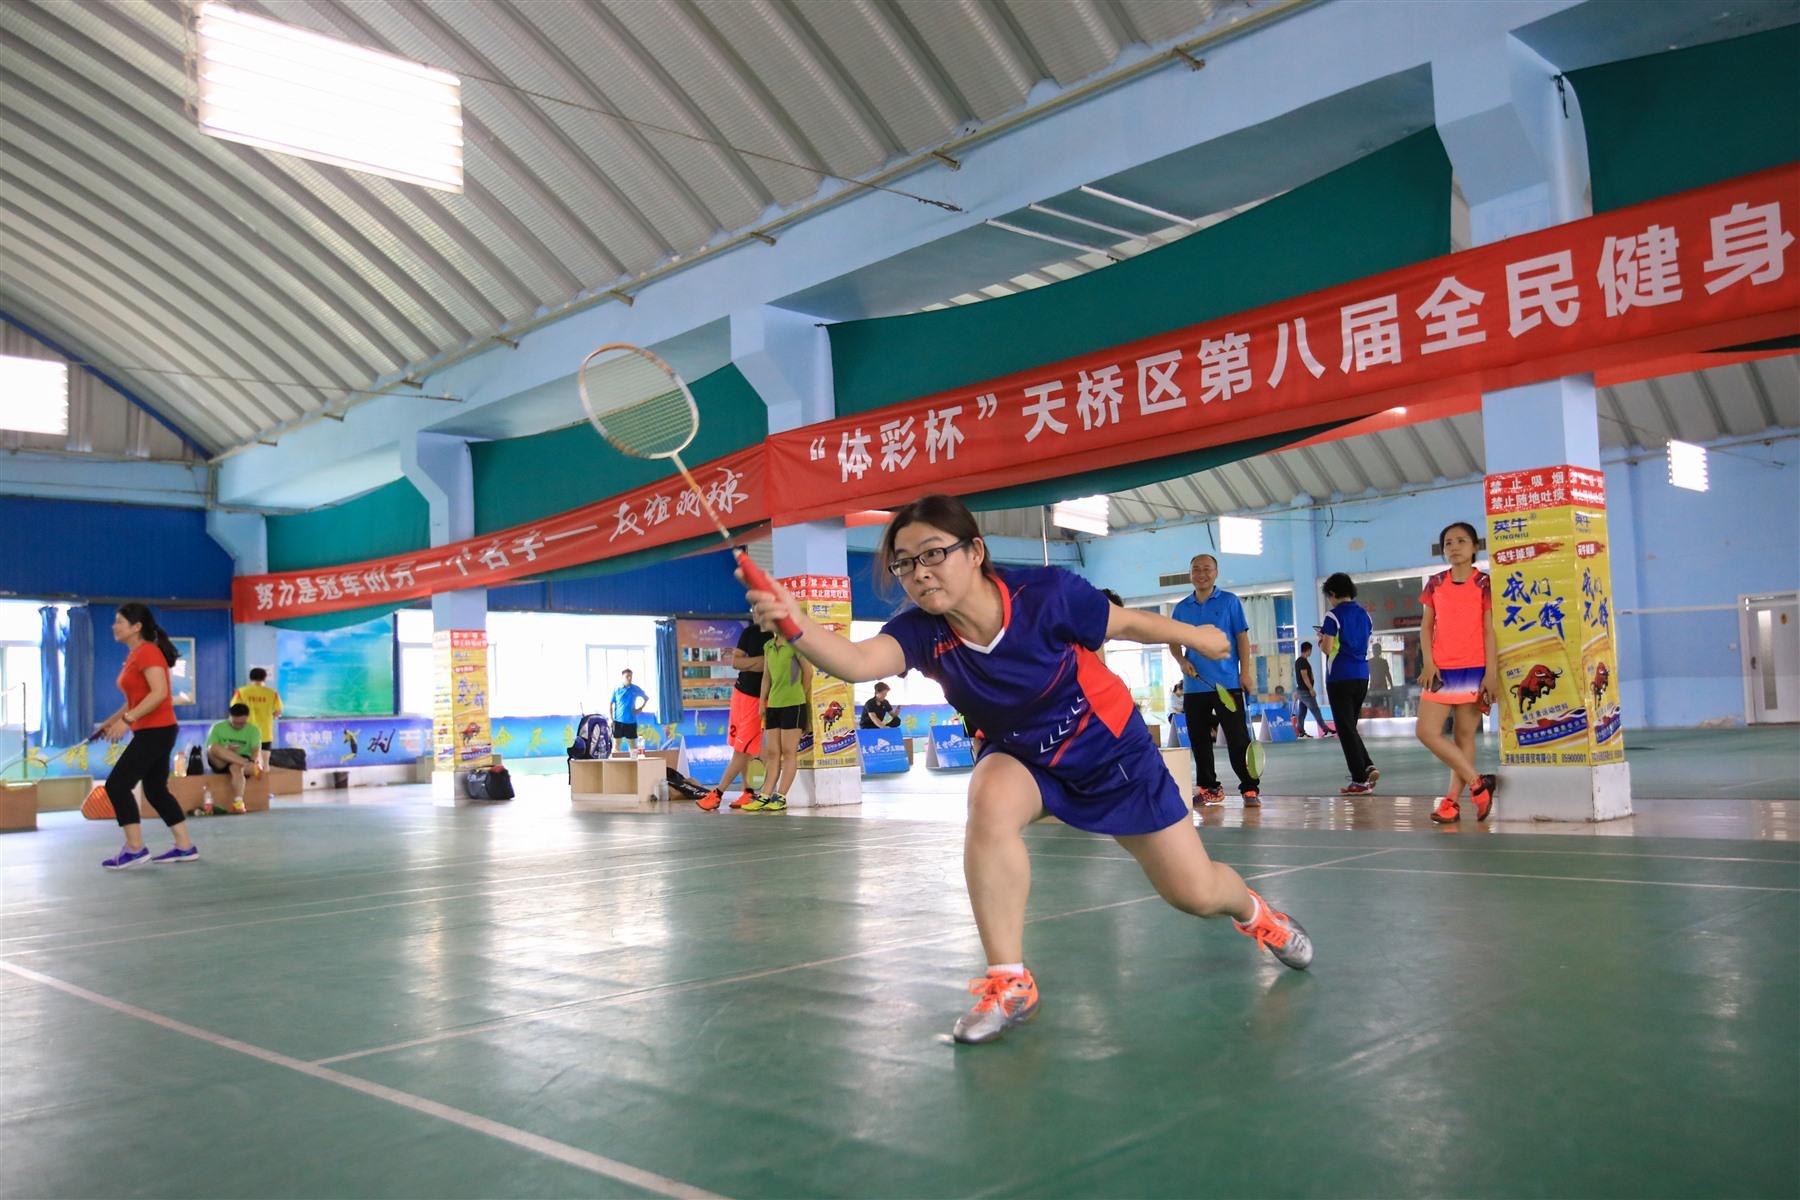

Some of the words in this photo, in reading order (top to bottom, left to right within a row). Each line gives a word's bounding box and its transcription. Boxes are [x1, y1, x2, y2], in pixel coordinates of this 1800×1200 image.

[1490, 471, 1565, 495] 禁止吸烟
[1491, 488, 1566, 510] 禁止随地吐痰
[1493, 517, 1528, 534] 英牛
[1494, 532, 1529, 540] YINGNIU
[1502, 570, 1551, 605] 我们
[1503, 597, 1566, 641] 不一样
